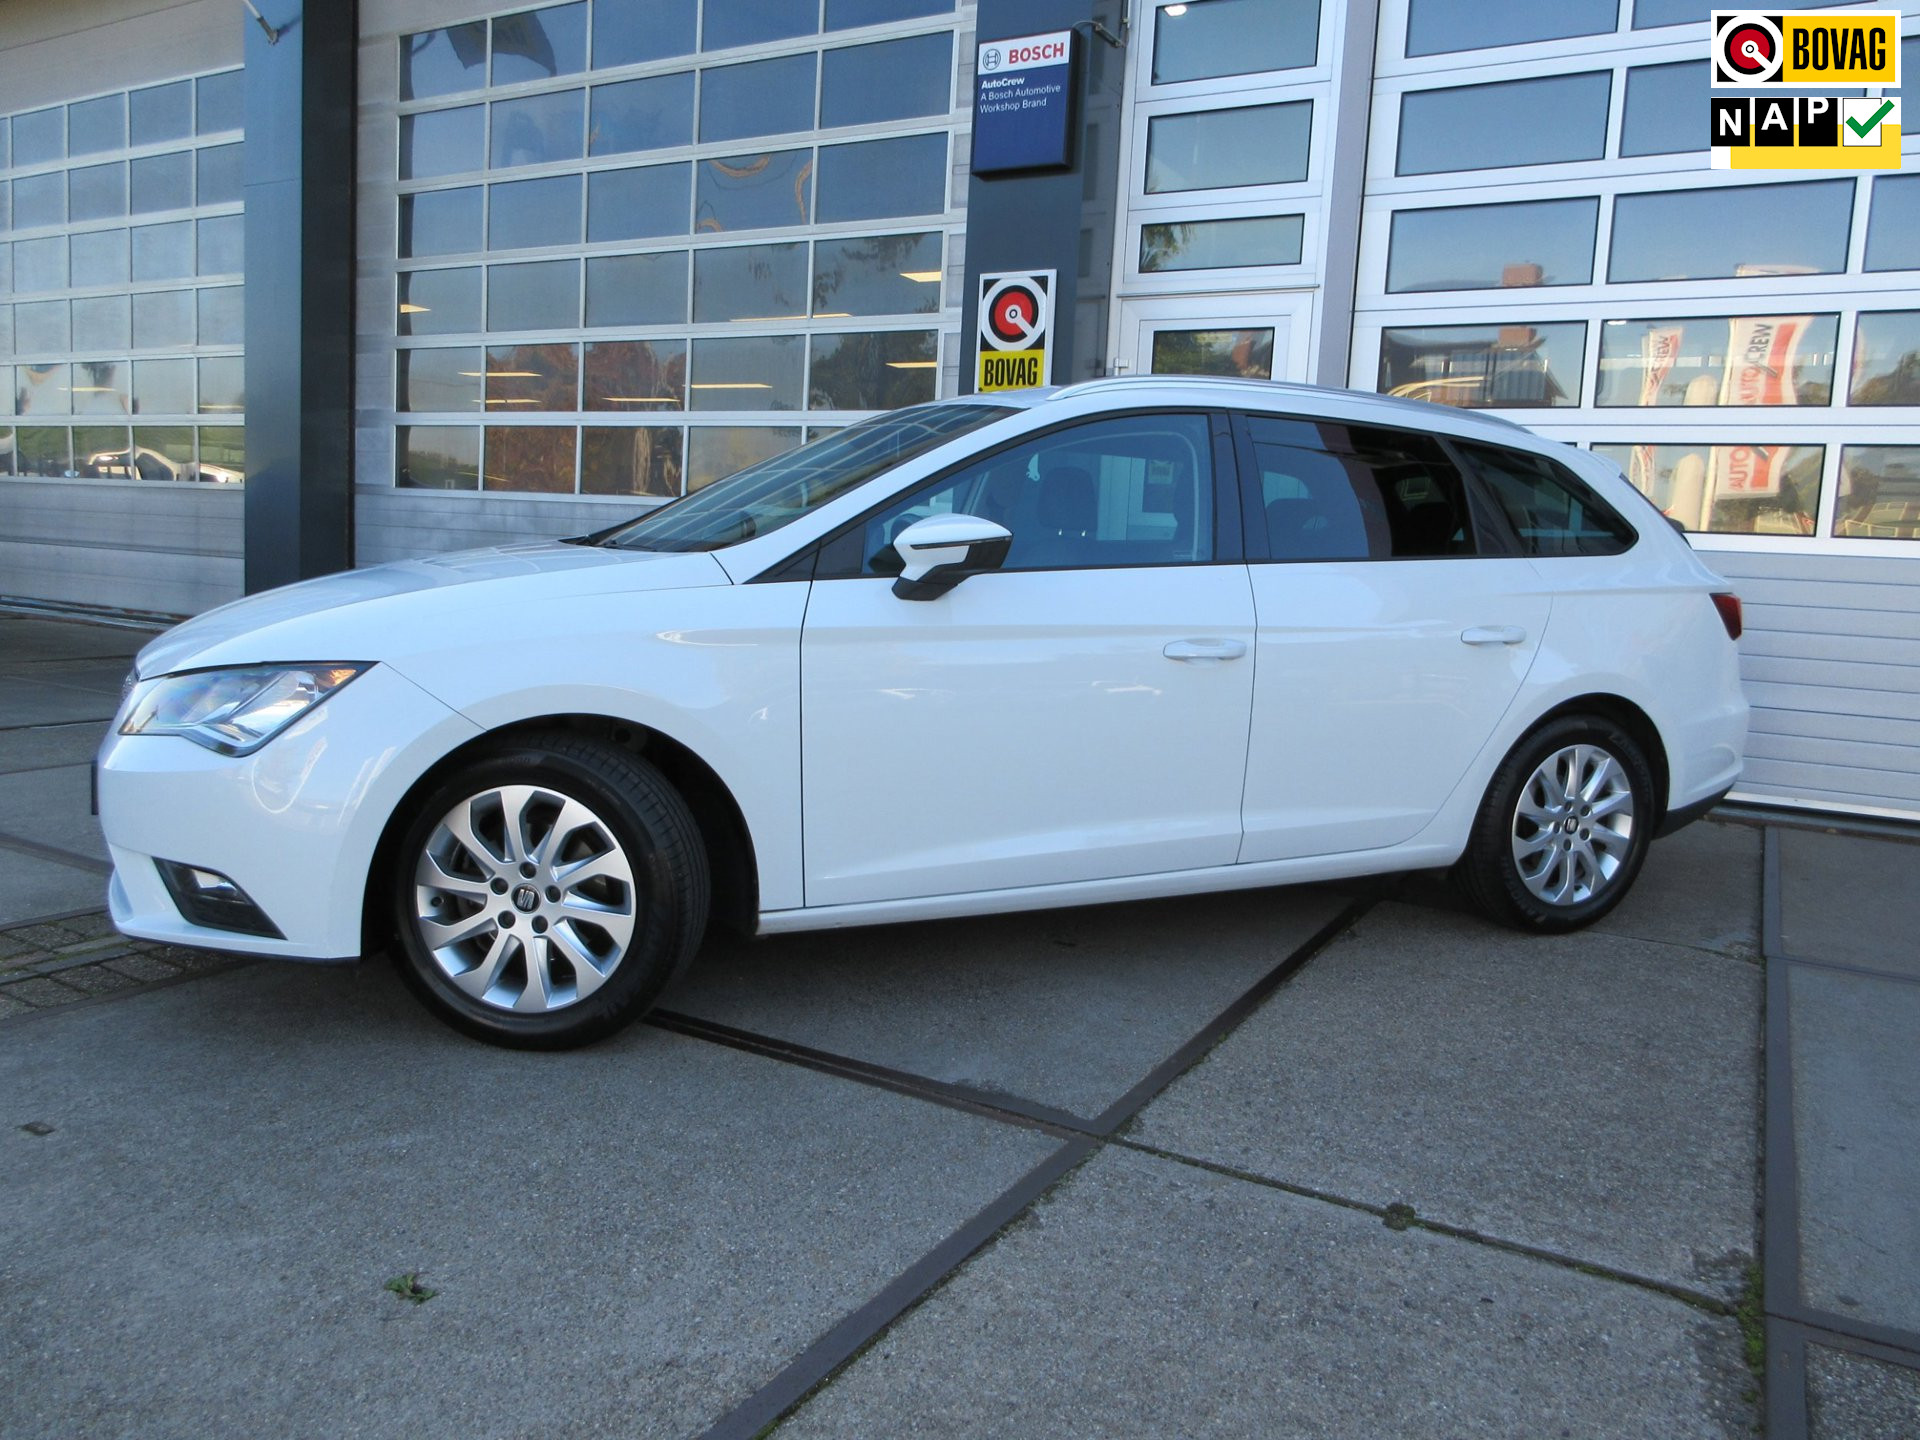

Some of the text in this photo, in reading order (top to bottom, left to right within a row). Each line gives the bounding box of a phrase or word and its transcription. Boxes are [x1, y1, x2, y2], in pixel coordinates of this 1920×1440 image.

[1008, 42, 1064, 64] BOSCH
[981, 76, 1025, 90] AutoCrew
[980, 84, 1061, 101] A Bosch Automotive
[980, 98, 1047, 114] Workshop Brand
[983, 357, 1038, 387] BOVAG
